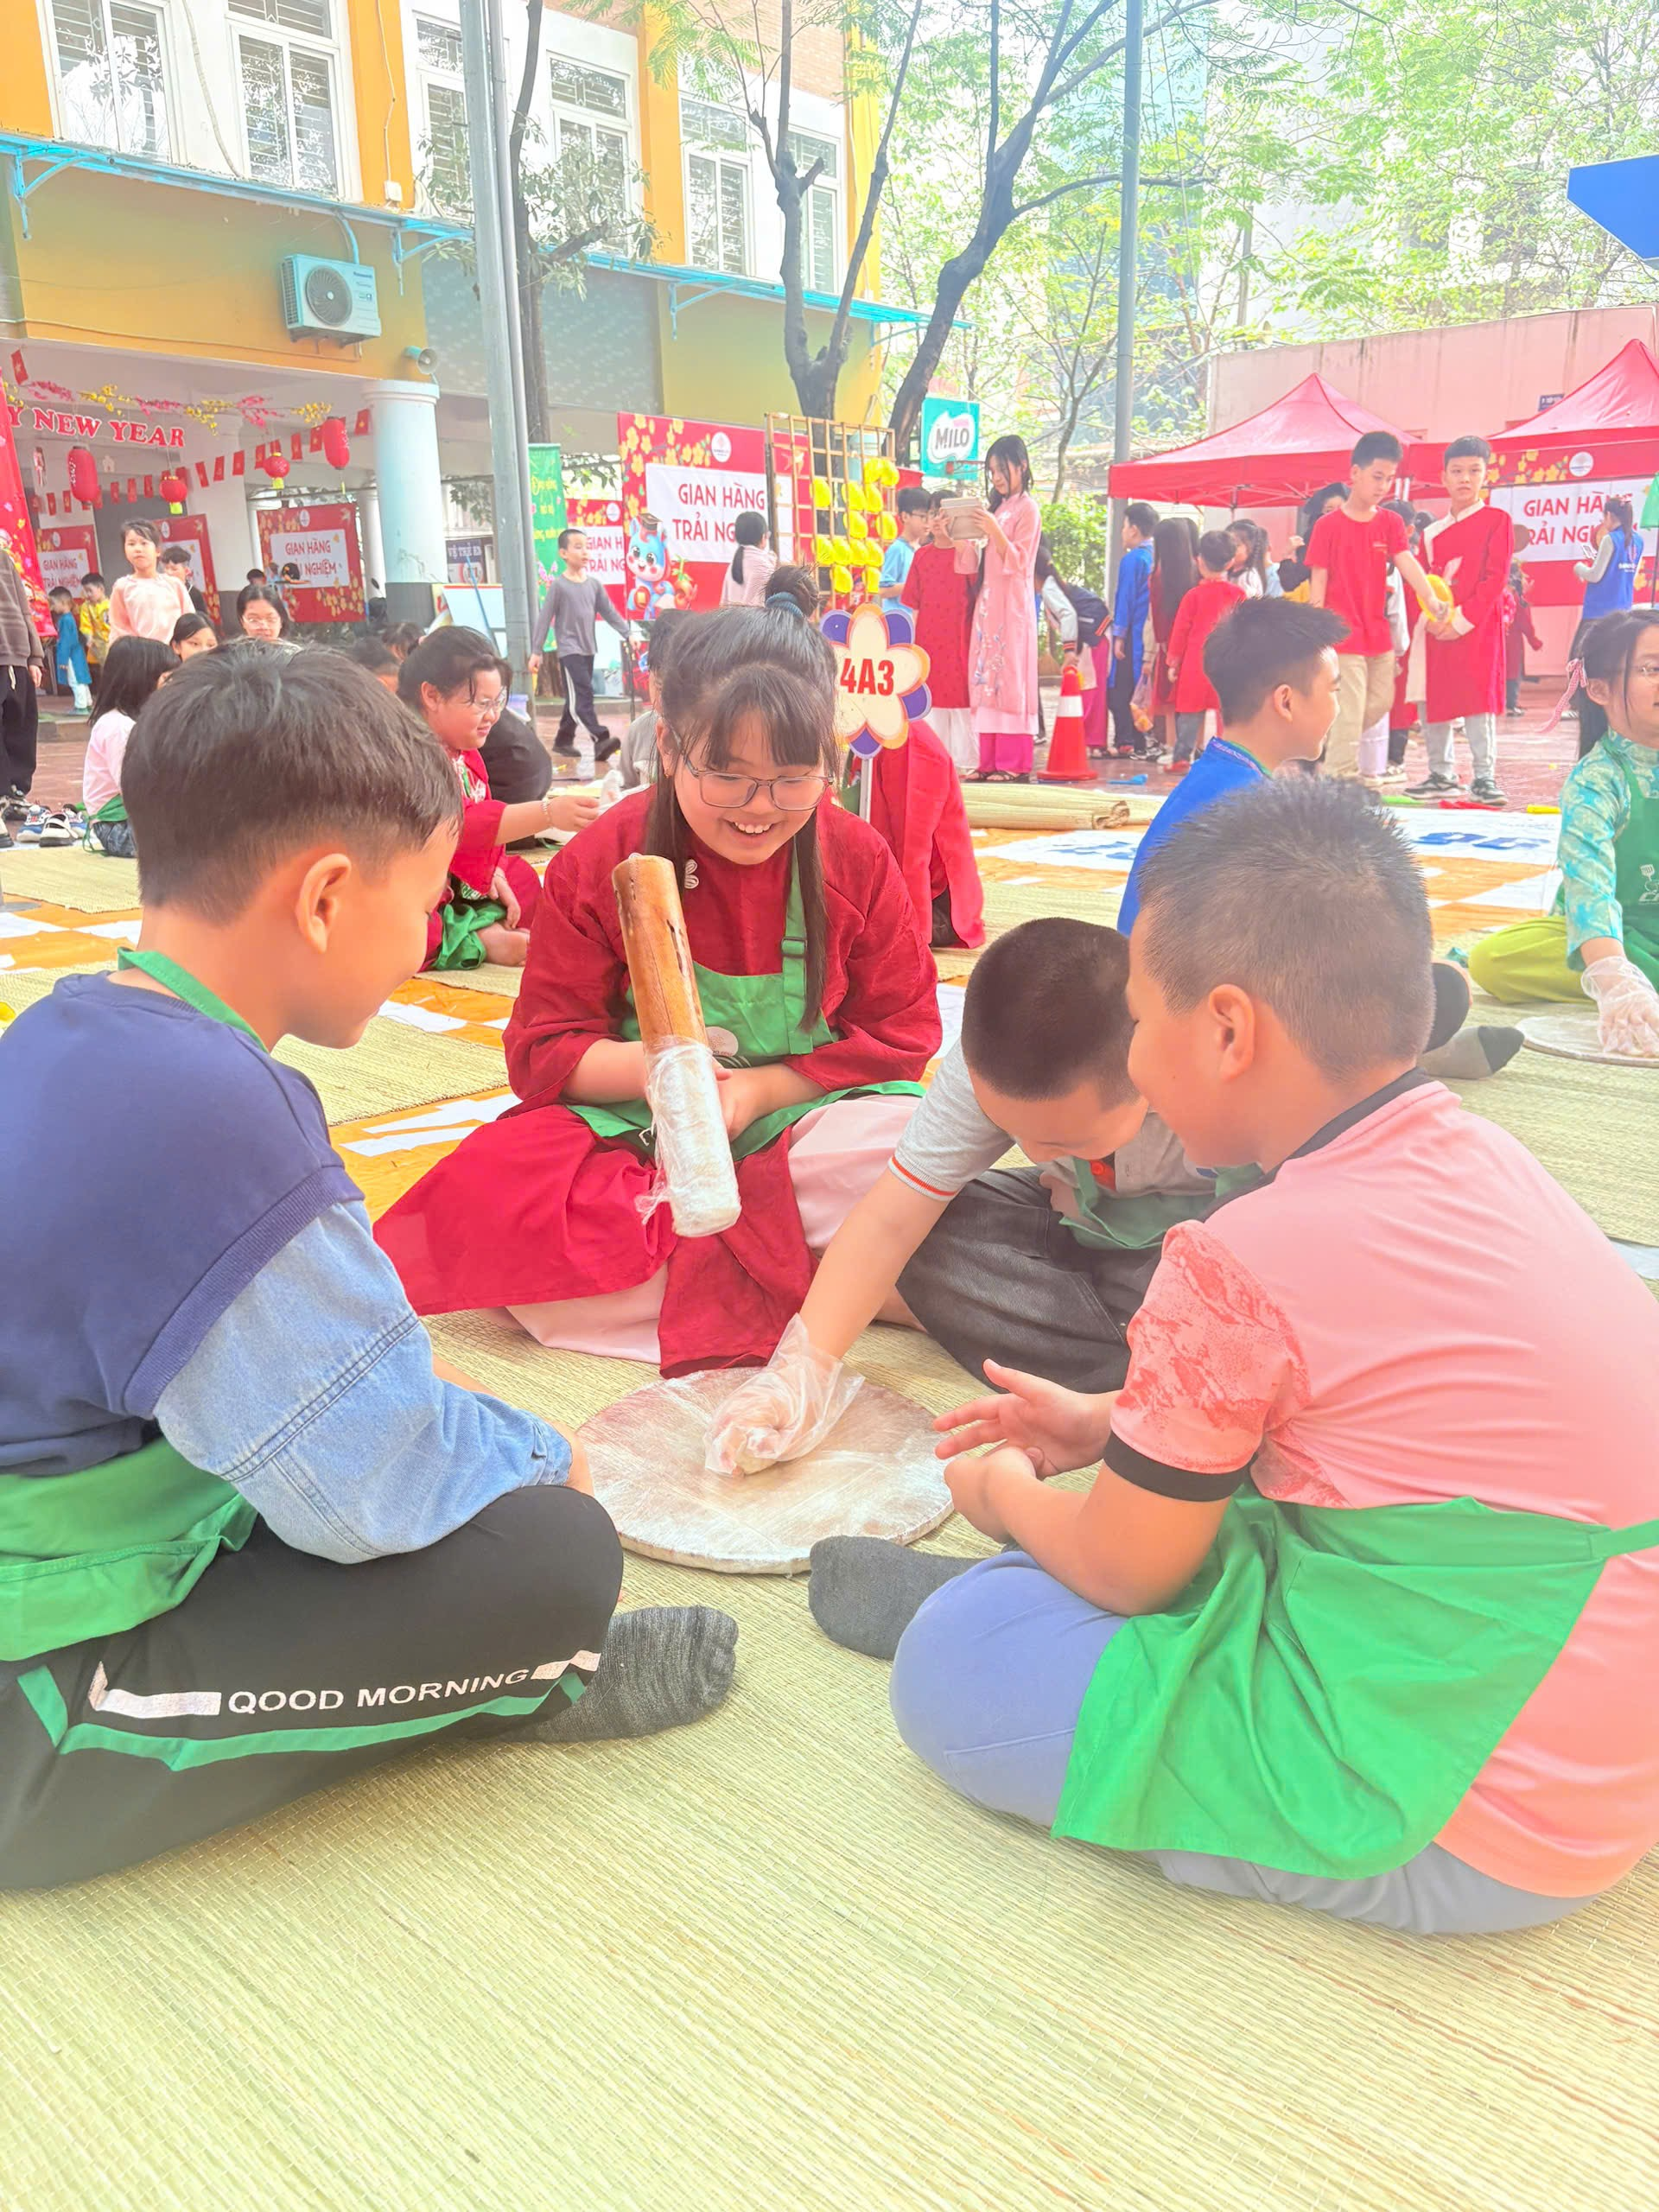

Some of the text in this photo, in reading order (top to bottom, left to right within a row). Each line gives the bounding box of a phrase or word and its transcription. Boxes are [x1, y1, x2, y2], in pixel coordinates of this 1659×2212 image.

[33, 408, 102, 438] NEW
[108, 421, 185, 448] YEAR
[935, 428, 969, 449] MILO
[678, 482, 765, 510] GIAN HÀNG
[1523, 497, 1569, 517] GIAN
[672, 512, 708, 541] TRẢI
[1528, 521, 1554, 545] RẢI
[285, 537, 331, 555] GIAN HÀNG
[304, 558, 337, 577] NGHIỆM
[840, 658, 894, 696] 4A3
[228, 1669, 530, 1714] QOOD MORNING
